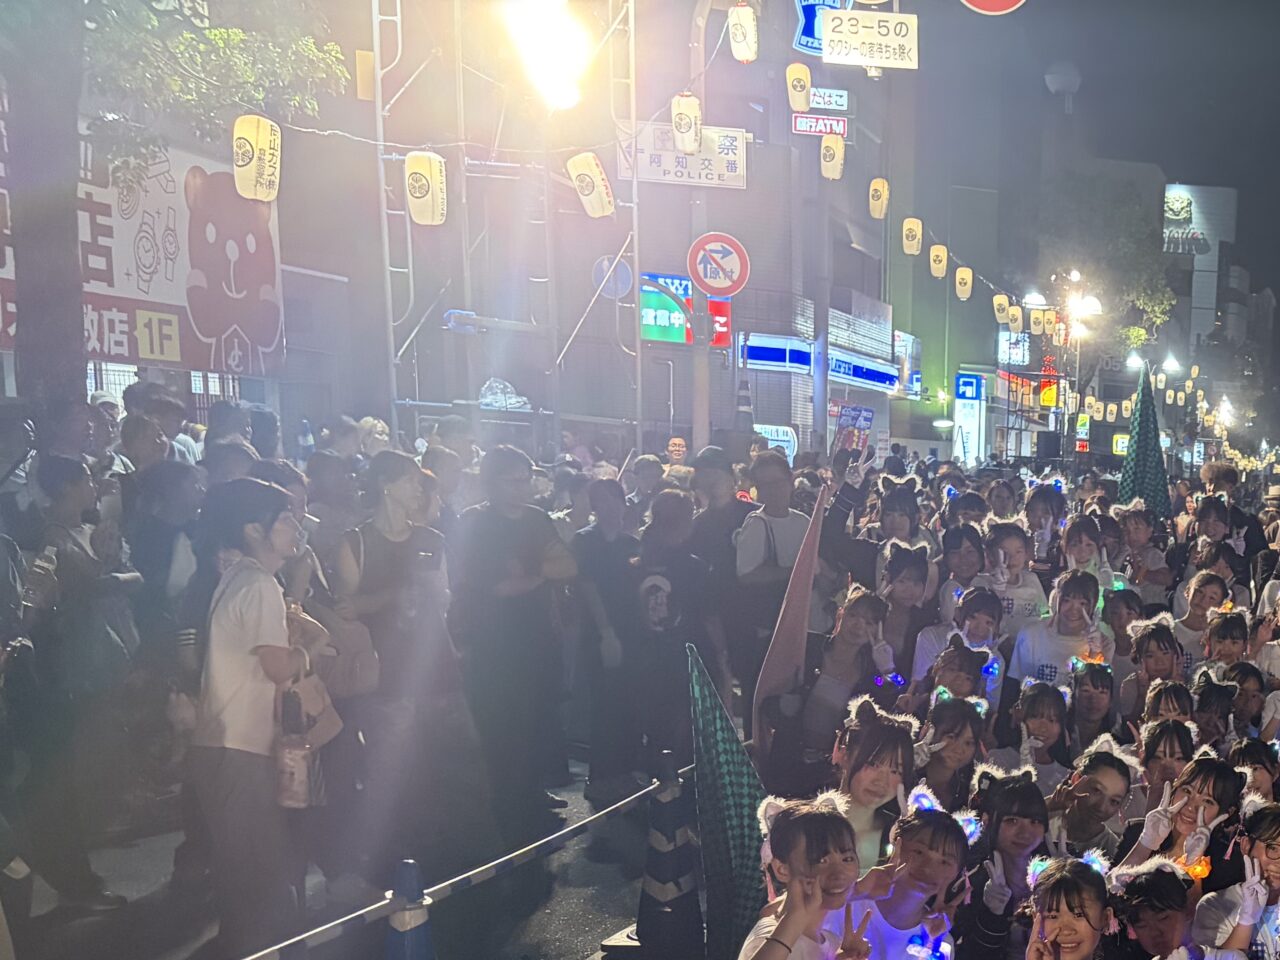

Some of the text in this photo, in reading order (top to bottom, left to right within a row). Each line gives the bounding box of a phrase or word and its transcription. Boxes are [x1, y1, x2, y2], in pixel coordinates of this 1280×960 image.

[650, 153, 739, 174] 阿知交番
[663, 168, 726, 181] POLICE
[143, 316, 173, 356] 1F
